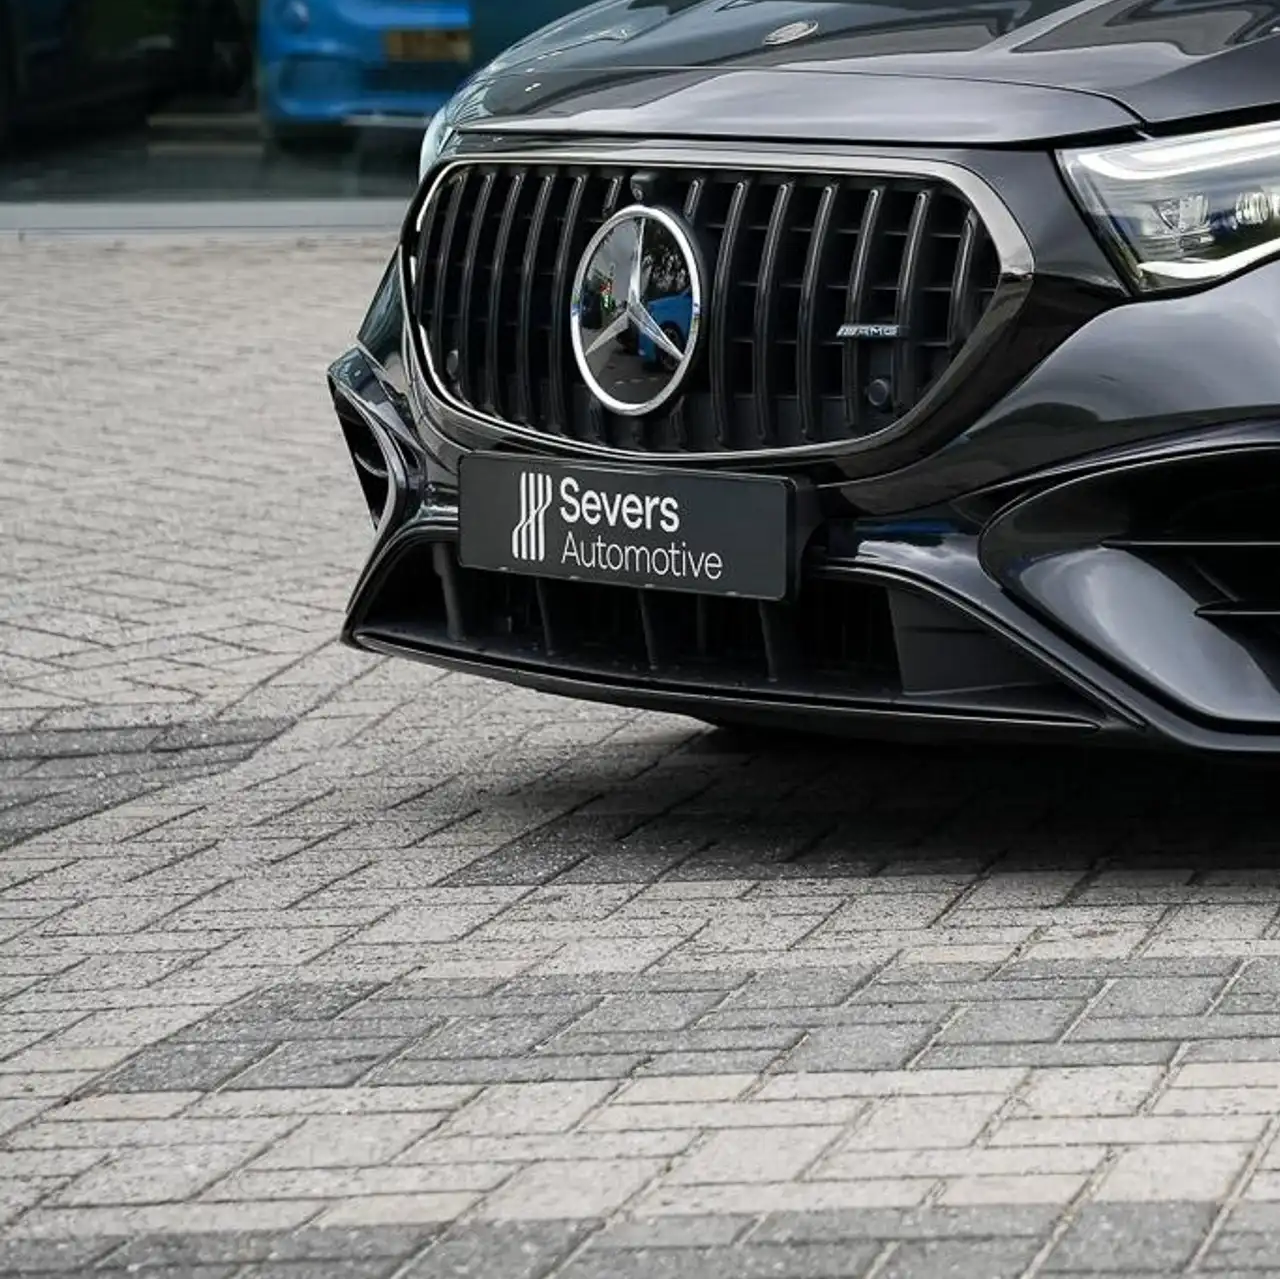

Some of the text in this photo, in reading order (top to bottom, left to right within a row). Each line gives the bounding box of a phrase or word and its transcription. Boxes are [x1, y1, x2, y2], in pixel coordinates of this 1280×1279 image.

[854, 325, 898, 337] AMG
[559, 476, 680, 533] Severs
[561, 531, 723, 580] Automotive
